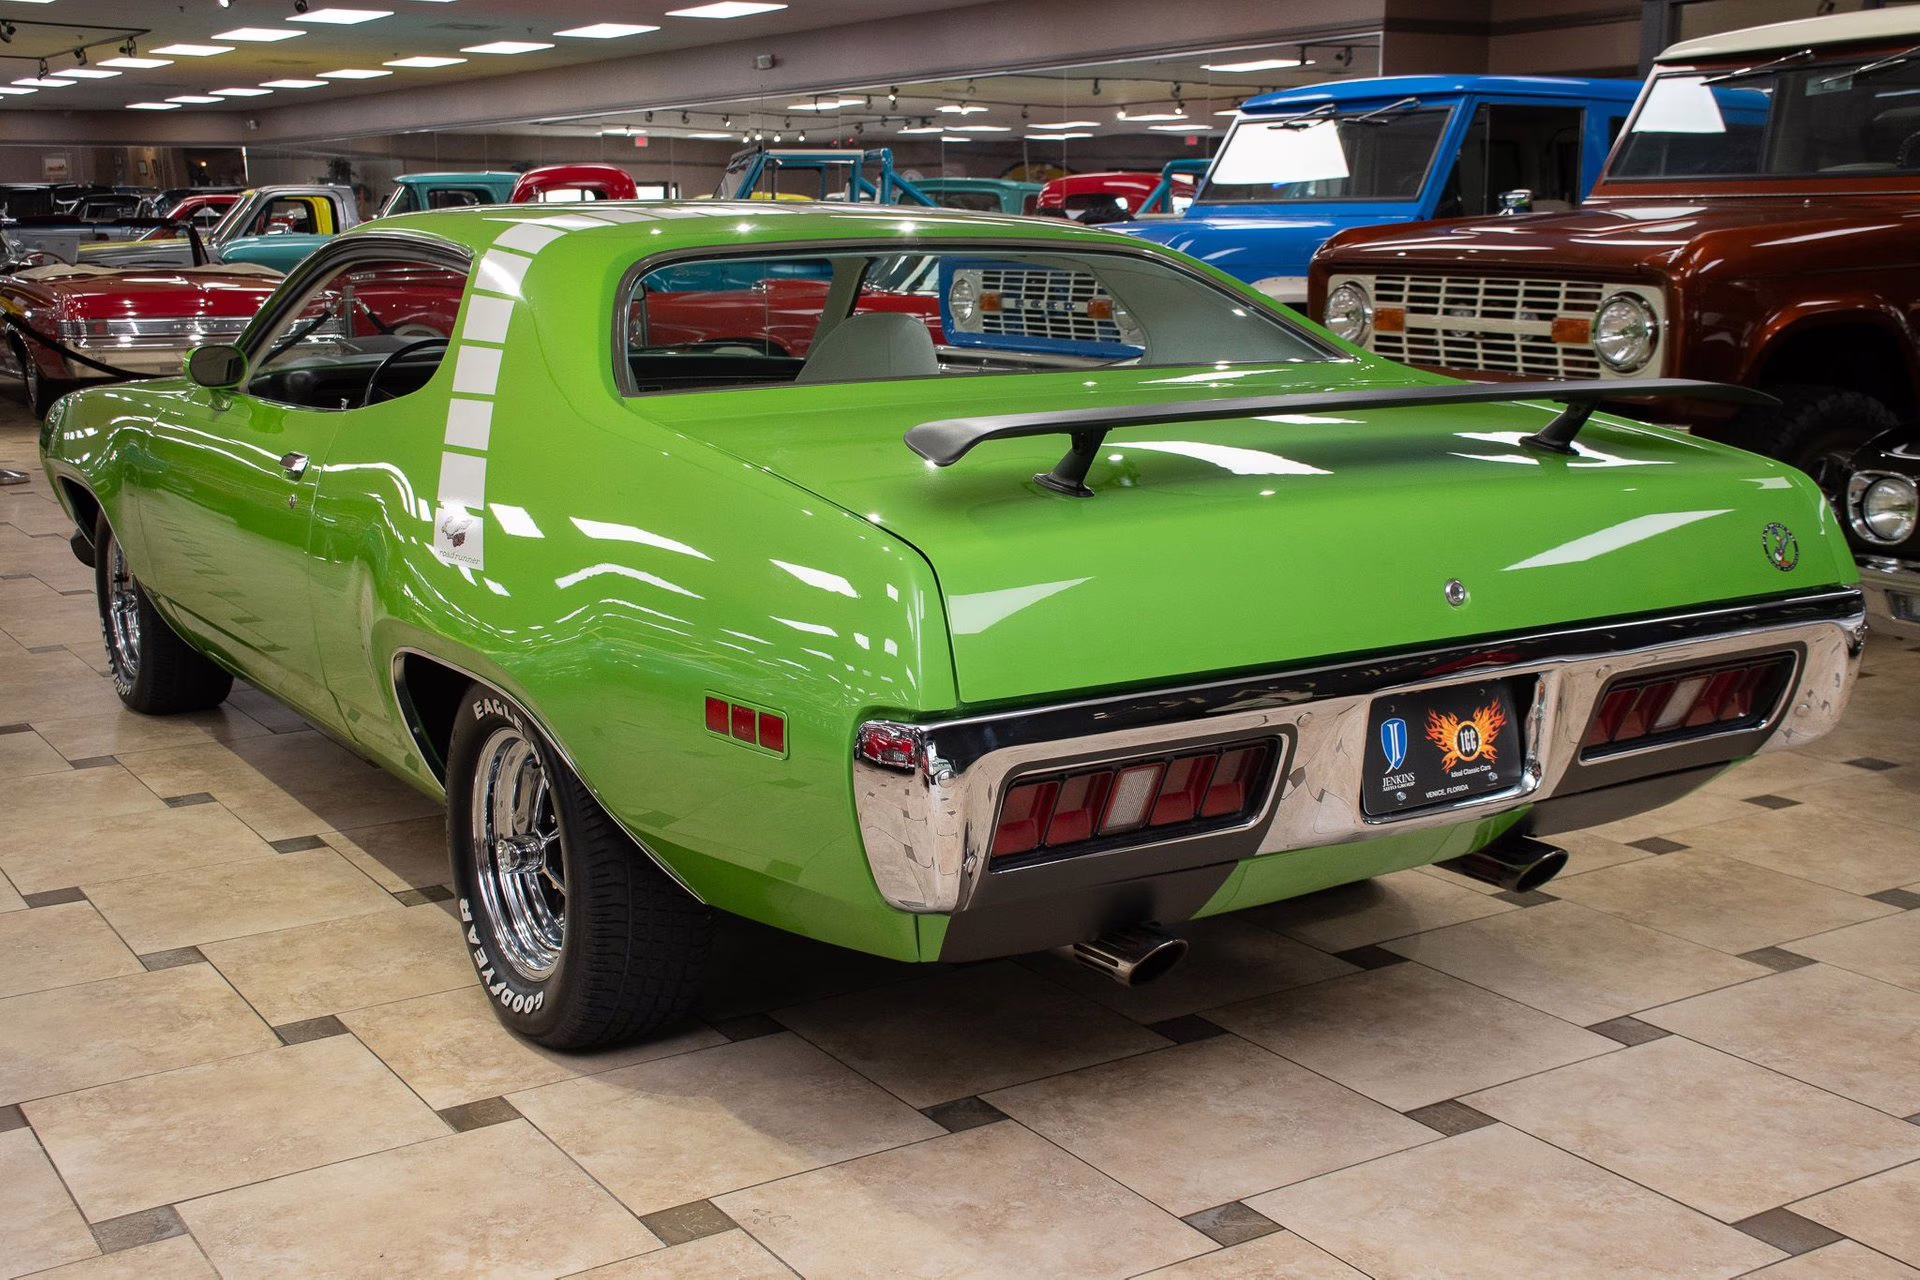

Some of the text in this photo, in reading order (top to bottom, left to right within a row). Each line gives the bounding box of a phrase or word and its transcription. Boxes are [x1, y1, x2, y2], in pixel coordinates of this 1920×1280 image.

[472, 698, 524, 735] EAGLE
[1459, 729, 1477, 753] ICC
[1382, 772, 1415, 787] JENKINS
[1463, 766, 1480, 776] Classic
[1480, 764, 1492, 772] Cars
[1425, 784, 1469, 799] VENICE, FLORIDA
[459, 898, 544, 1014] GOODYEAR
